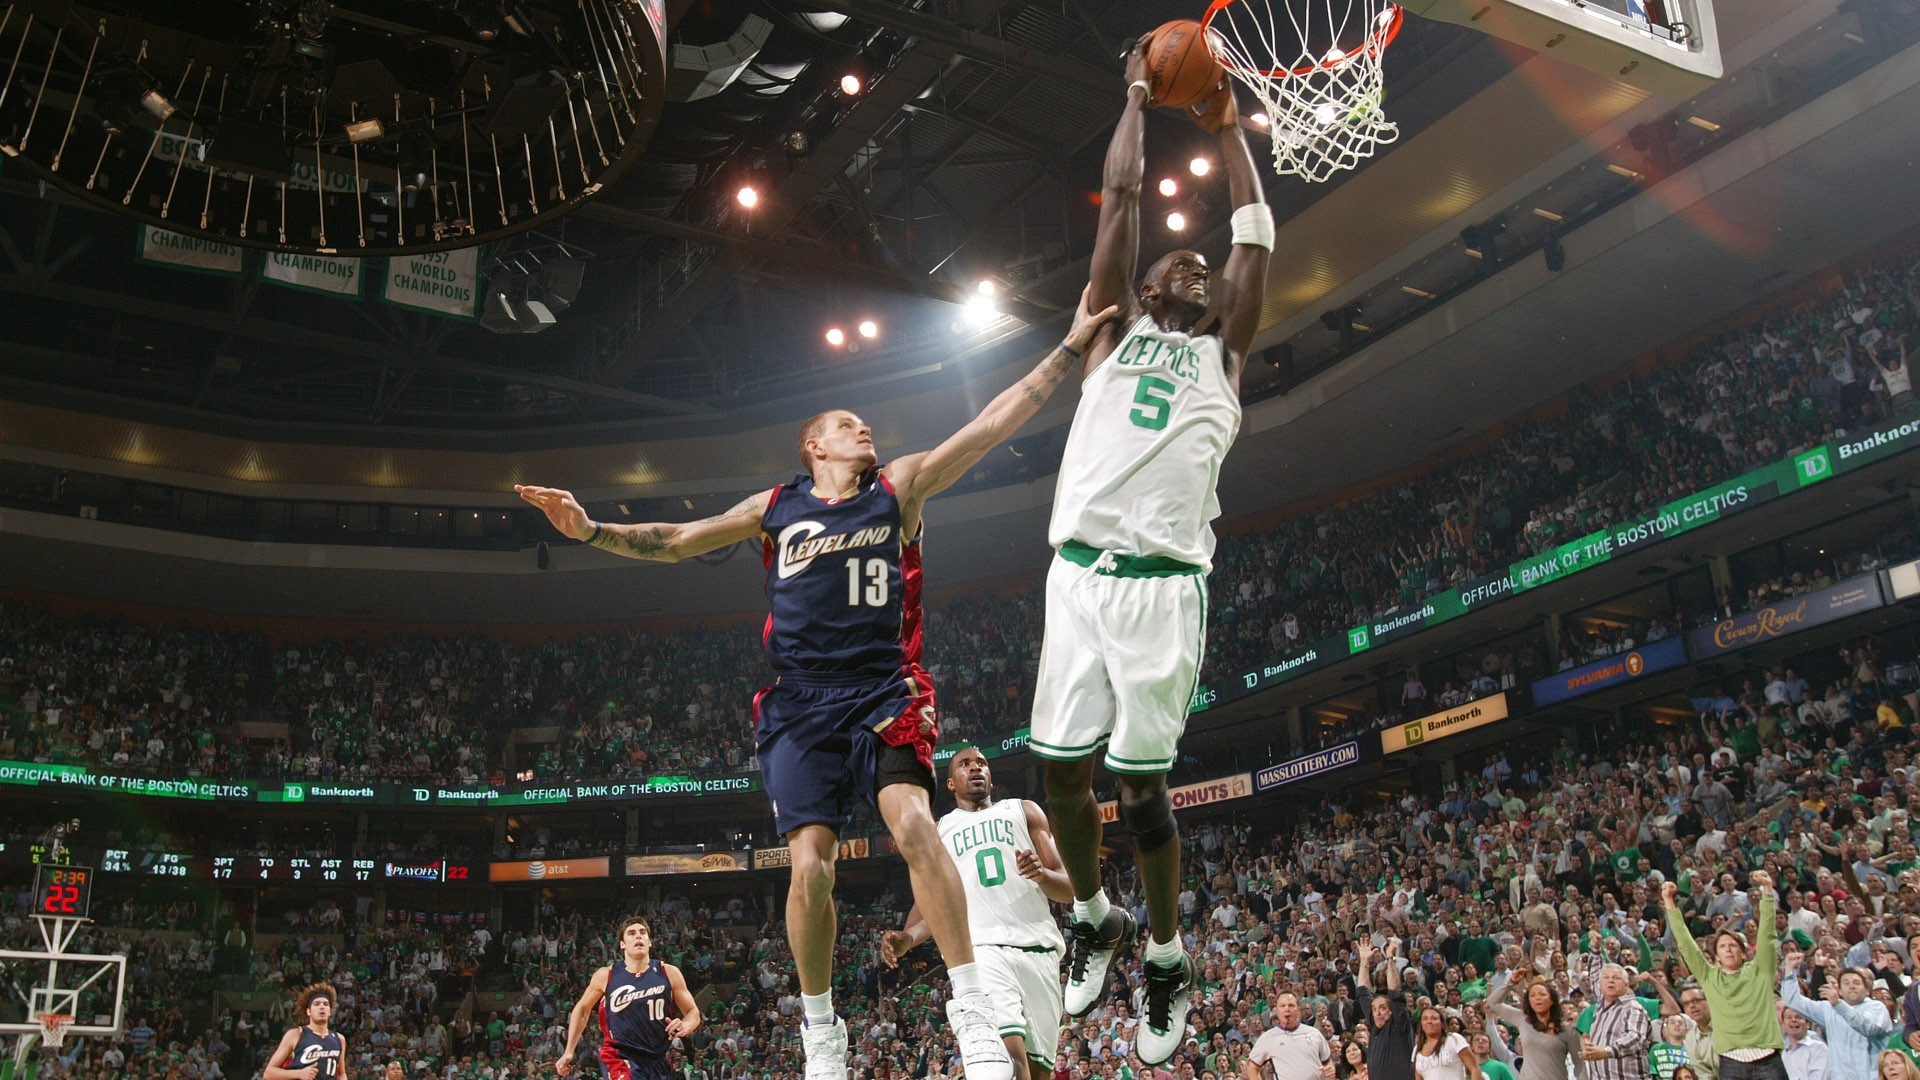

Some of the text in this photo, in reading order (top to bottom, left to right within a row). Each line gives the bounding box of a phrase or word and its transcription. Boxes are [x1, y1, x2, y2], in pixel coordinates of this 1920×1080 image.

[150, 229, 237, 258] CHAMPIONS
[273, 251, 355, 279] CHAMPIONS
[410, 260, 457, 283] WORLD
[393, 273, 471, 303] CHAMPIONS
[1129, 375, 1176, 432] 5
[1798, 453, 1828, 478] TD
[777, 520, 891, 580] CLEVELAND
[1461, 485, 1749, 607] OFFICIAL BANK OF THE BOSTON CELTICS
[845, 557, 889, 607] 13
[1350, 603, 1436, 648] TD Banknorth
[1714, 600, 1807, 649] Crown Royal
[1242, 649, 1318, 689] TD Banknorth
[1567, 661, 1625, 691] SYLVANIA
[1406, 707, 1482, 742] TD Banknorth
[1259, 745, 1356, 788] MASSLOTTERY.COM
[0, 766, 249, 797] OFFICIAL BANK OF THE BOSTON CELTICS
[286, 785, 374, 799] TD Banknorth
[523, 777, 750, 800] OFFICIAL BANK OF THE BOSTON CELTICS
[412, 788, 499, 801] TD Banknorth
[1170, 783, 1229, 808] ONUTS
[952, 818, 1015, 858] CELTICS
[105, 849, 129, 860] PCT
[163, 853, 179, 864] FG
[213, 857, 234, 867] 3PT
[259, 858, 274, 867] TO
[290, 858, 311, 868] STL
[320, 859, 342, 868] AST
[353, 859, 375, 869] REB
[756, 848, 791, 860] SPORTS
[53, 870, 86, 886] 2:39
[260, 869, 269, 879] 4
[293, 870, 301, 879] 3
[323, 870, 337, 880] 10
[355, 870, 370, 880] 17
[392, 865, 440, 877] PLAYOFFS
[446, 866, 470, 879] 22
[548, 863, 569, 875] at&t
[975, 846, 1007, 888] 0
[45, 885, 79, 913] 22
[609, 984, 666, 1013] CLEVELAND
[646, 998, 665, 1021] 10
